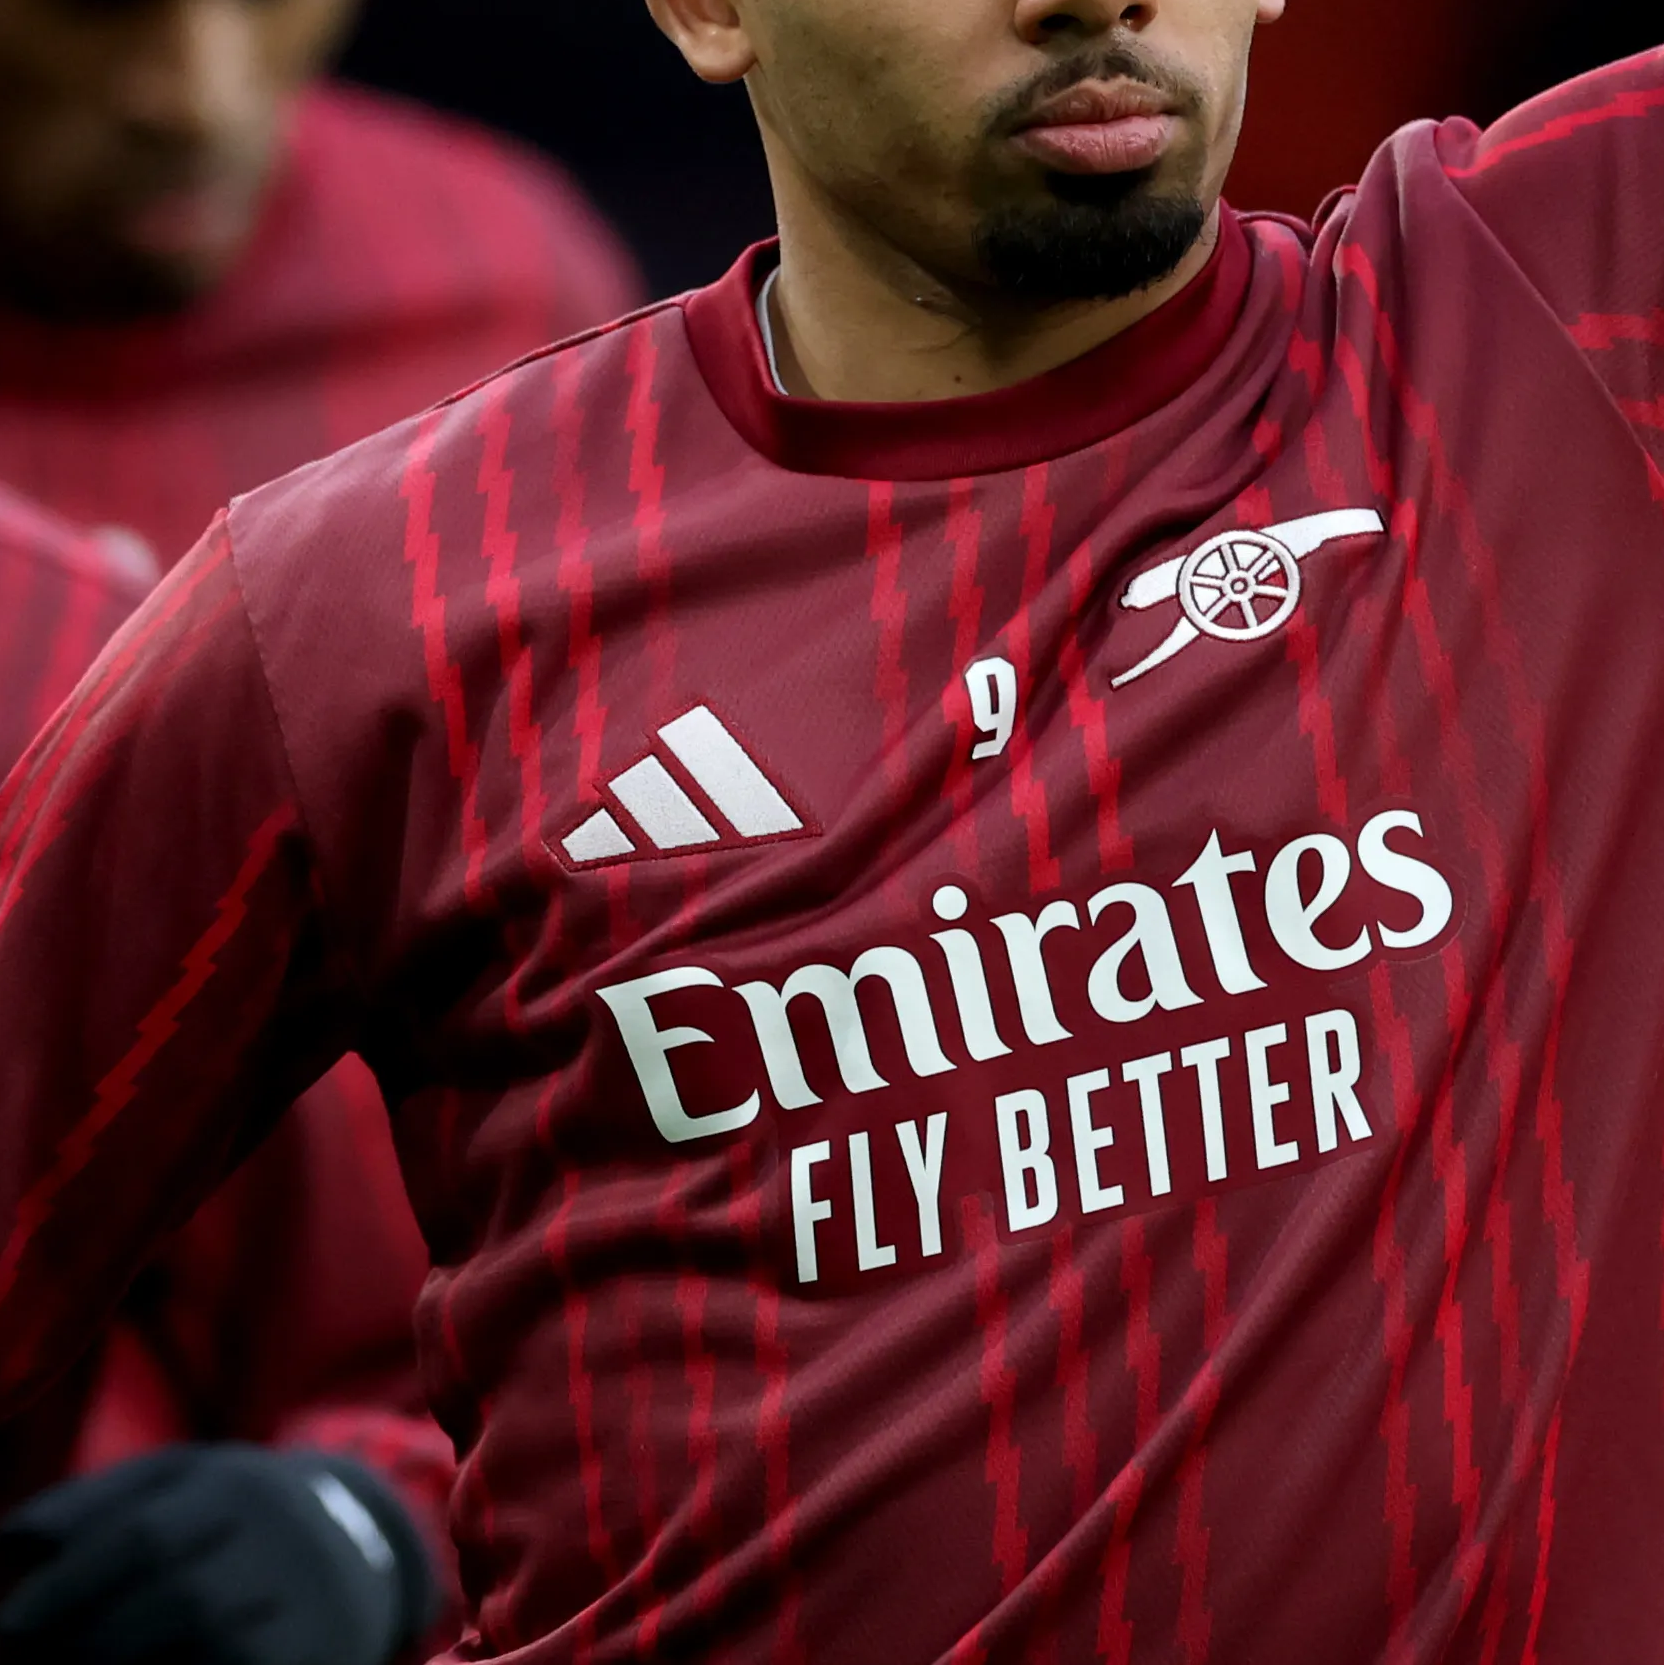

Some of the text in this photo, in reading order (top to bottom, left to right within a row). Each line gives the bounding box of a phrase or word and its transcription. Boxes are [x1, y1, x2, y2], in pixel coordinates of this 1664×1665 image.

[964, 656, 1017, 759] 9
[595, 810, 1454, 1143] Emirates
[789, 1009, 1374, 1283] FLY BETTER
